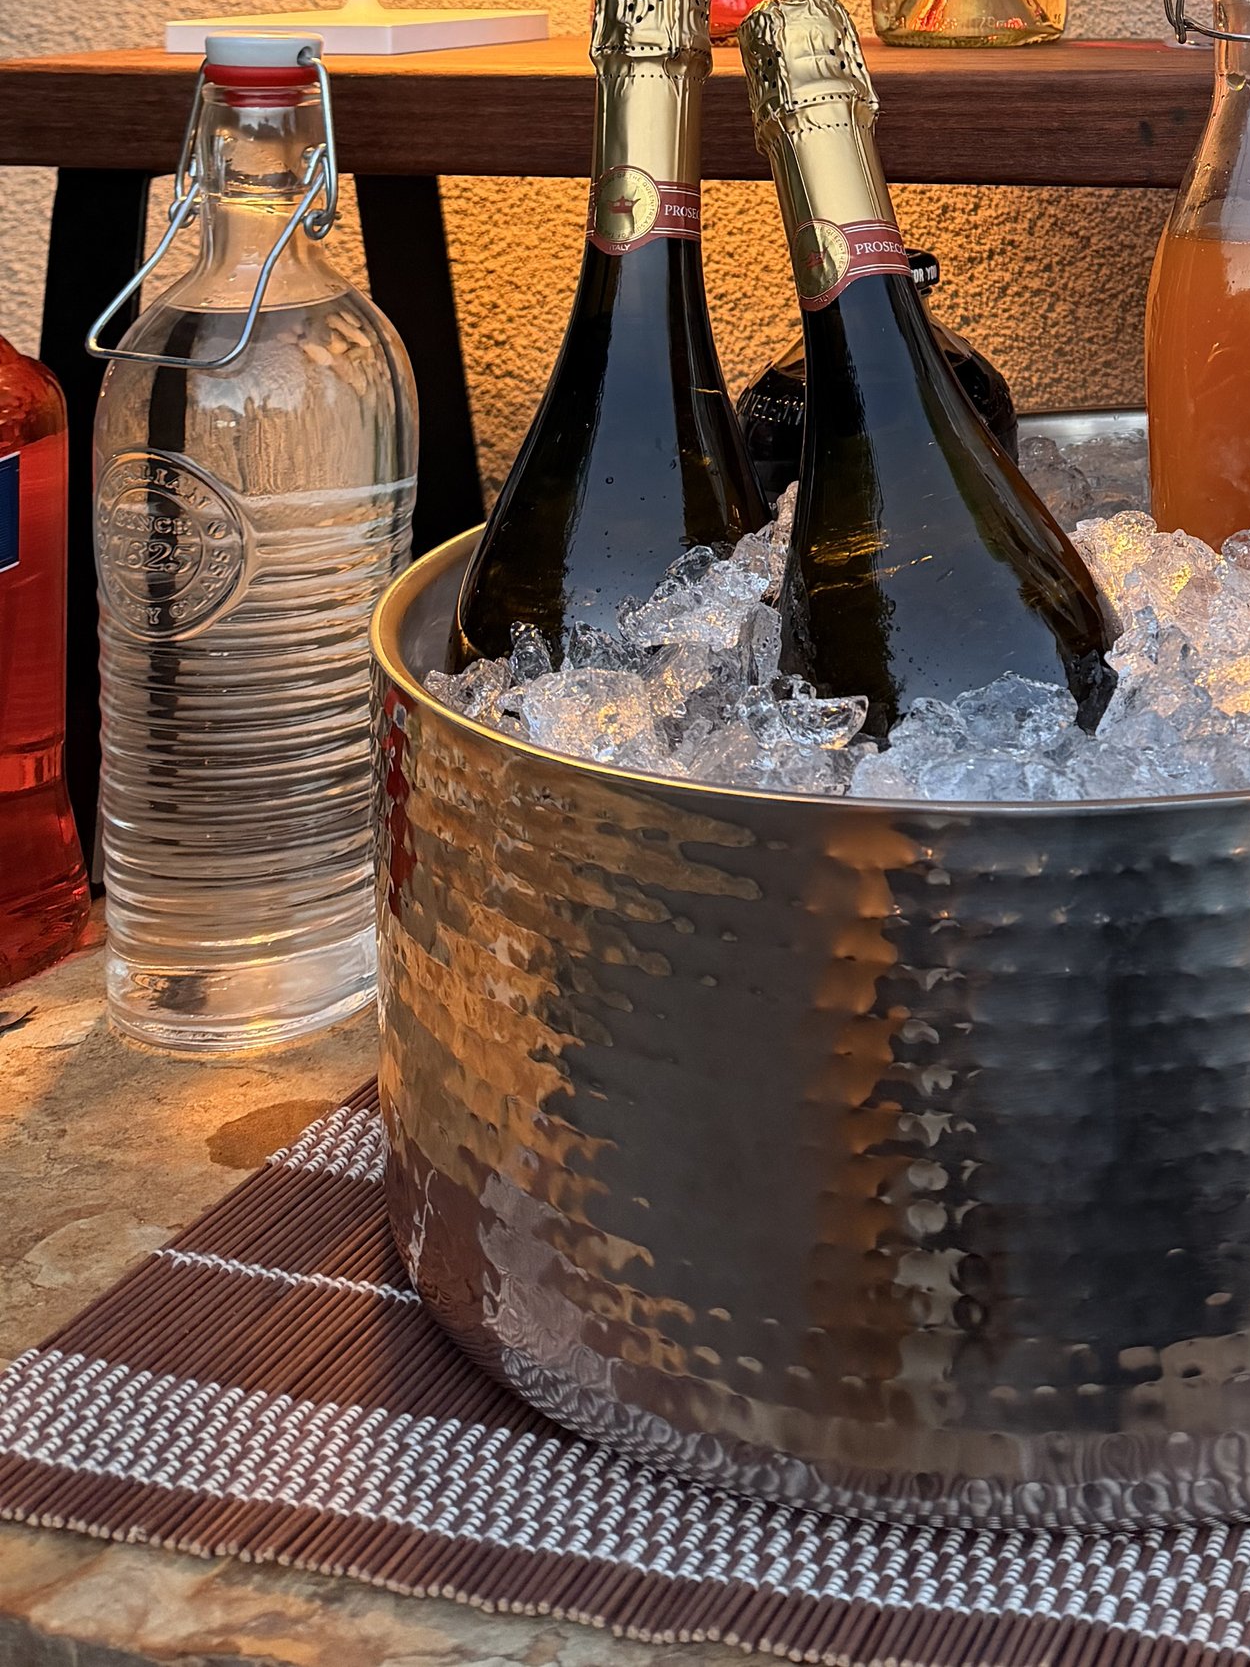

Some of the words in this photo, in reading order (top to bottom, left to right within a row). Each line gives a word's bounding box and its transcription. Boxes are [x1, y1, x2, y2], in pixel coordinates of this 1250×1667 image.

[664, 204, 700, 221] PROSEC
[609, 243, 631, 251] ITALY
[911, 268, 924, 284] OR
[114, 540, 197, 575] 1825
